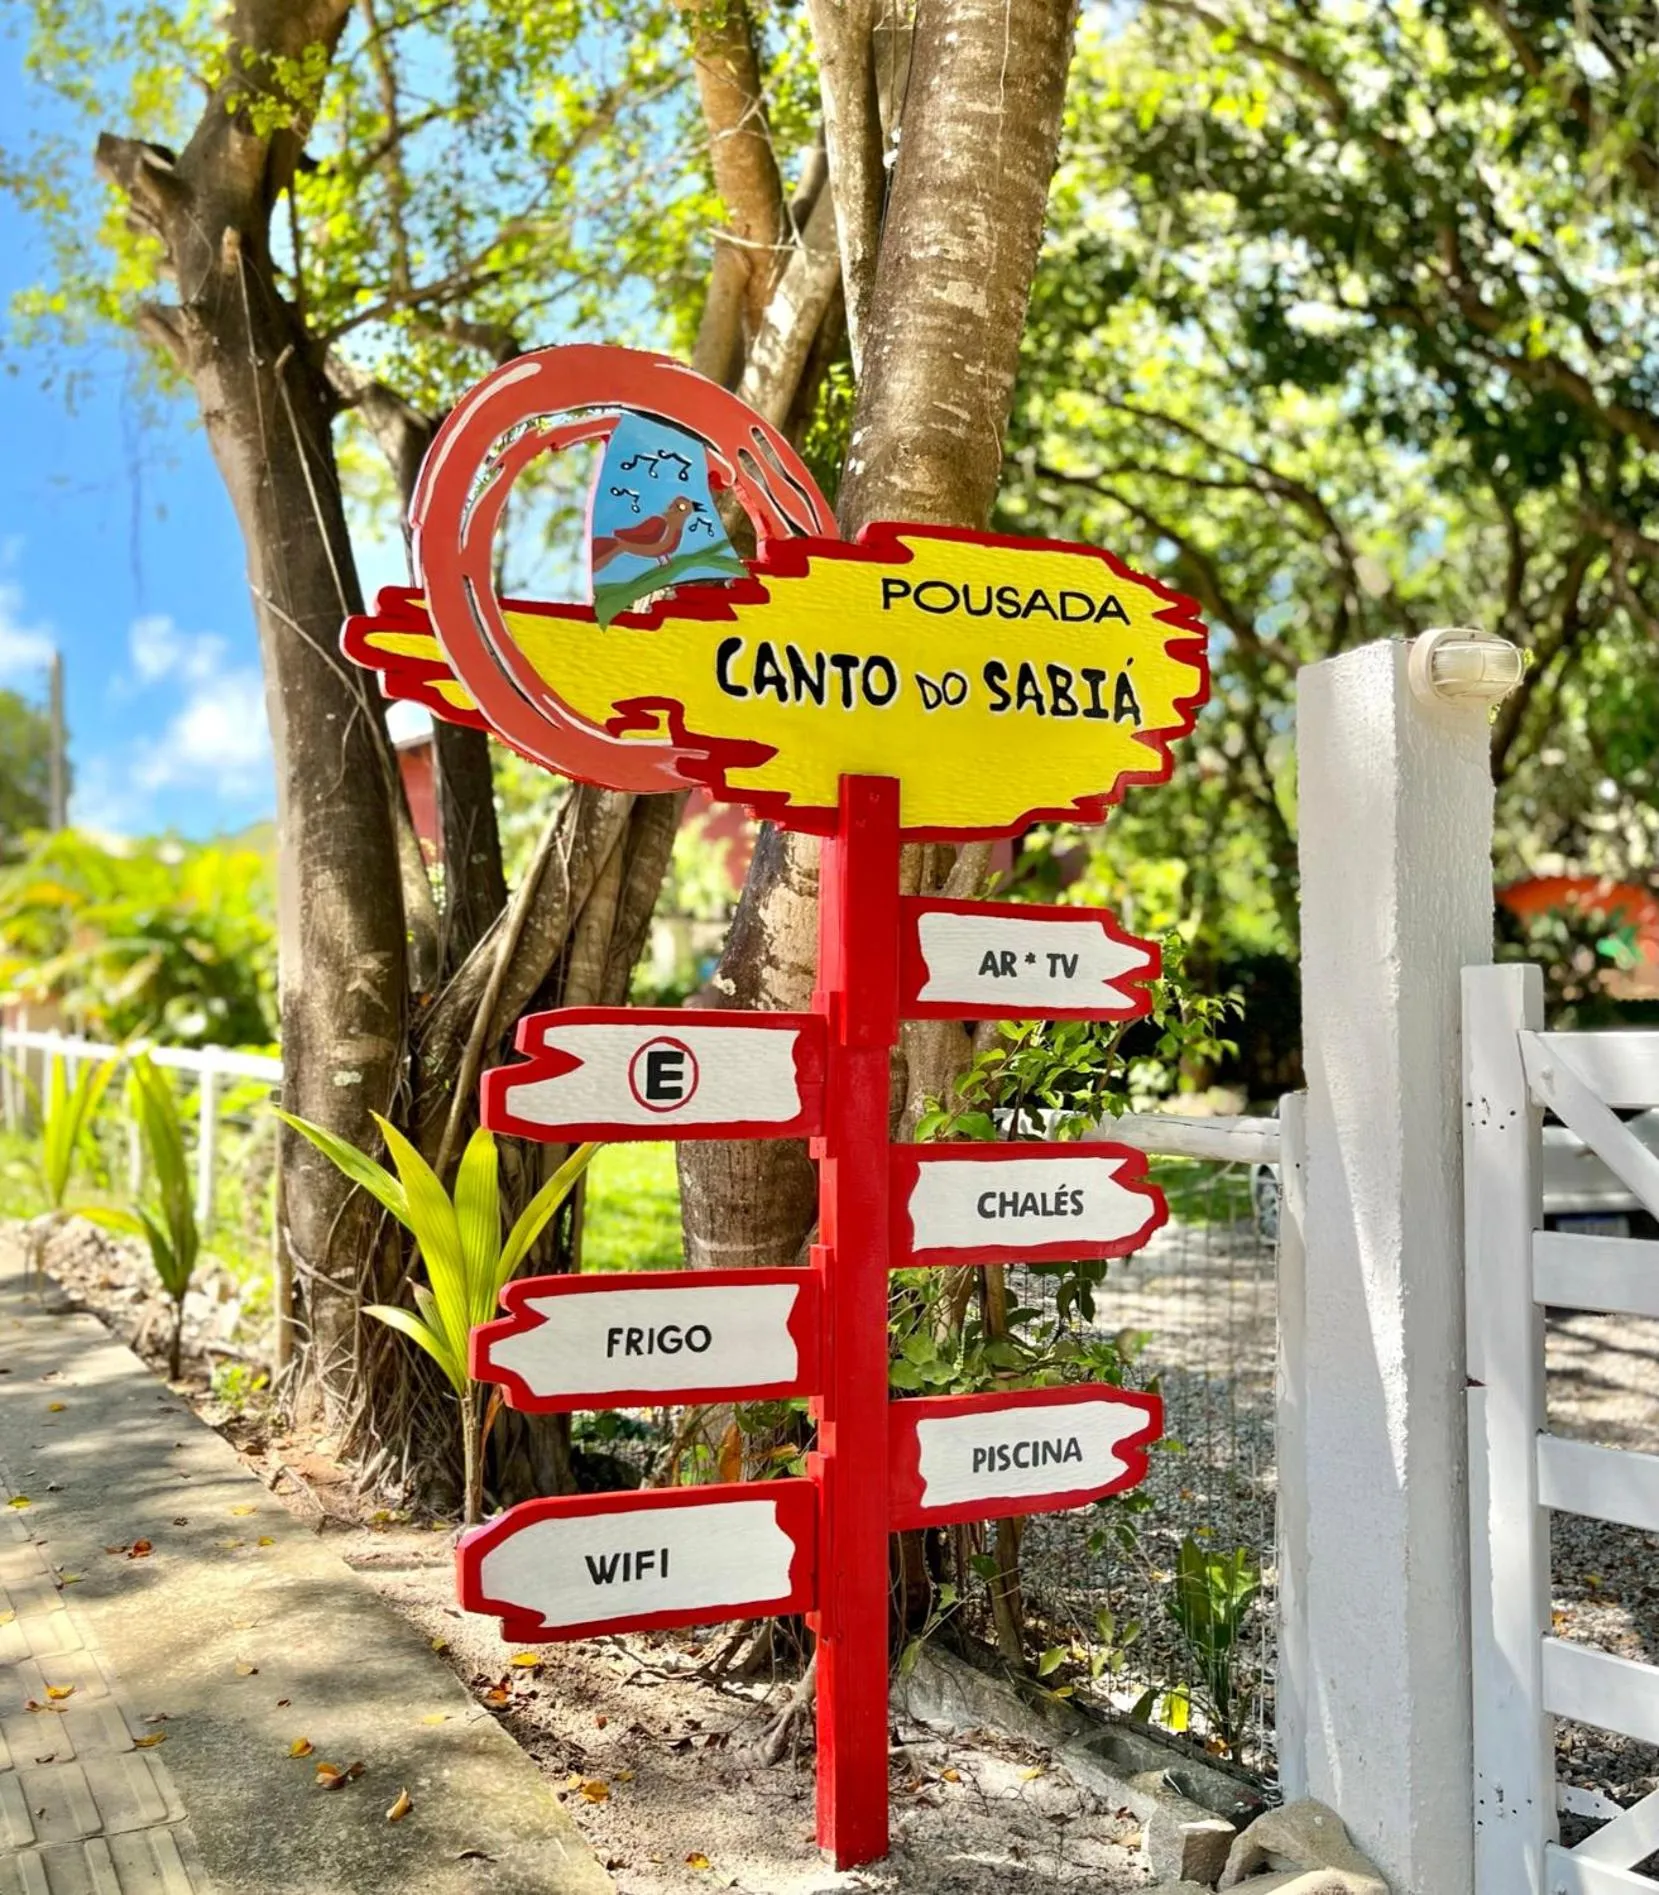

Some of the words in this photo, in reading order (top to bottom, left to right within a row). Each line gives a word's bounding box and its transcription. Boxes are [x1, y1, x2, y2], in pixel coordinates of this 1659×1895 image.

[881, 577, 1132, 626] POUSADA
[716, 636, 898, 710] CANTO
[914, 671, 968, 710] DO
[982, 657, 1142, 727] SABIÁ
[978, 950, 1018, 978] AR
[1046, 953, 1079, 979] TV
[646, 1050, 685, 1100] E
[977, 1183, 1085, 1219] CHALÉS
[607, 1324, 712, 1358] FRIGO
[973, 1437, 1082, 1473] PISCINA
[584, 1548, 669, 1585] WIFI
